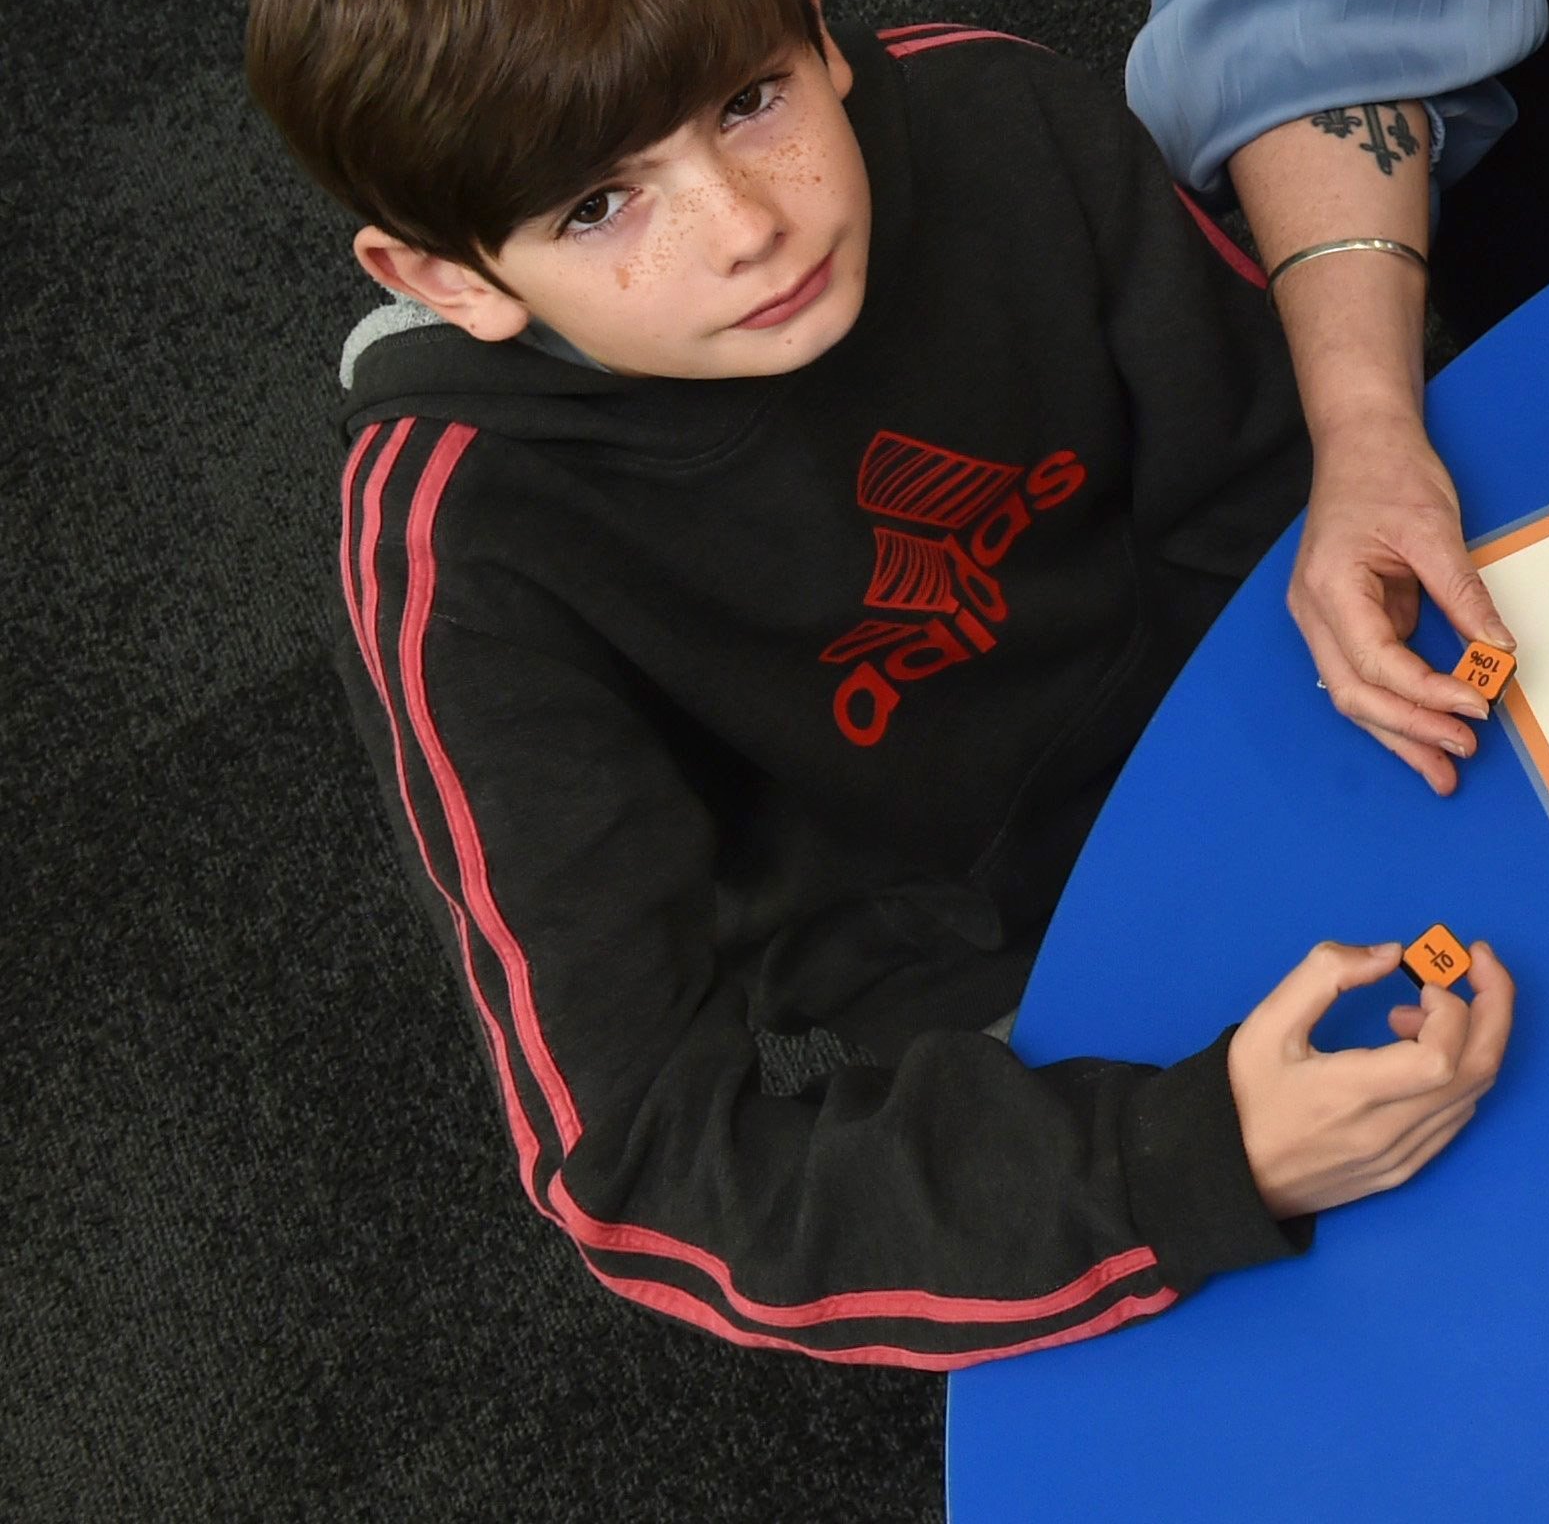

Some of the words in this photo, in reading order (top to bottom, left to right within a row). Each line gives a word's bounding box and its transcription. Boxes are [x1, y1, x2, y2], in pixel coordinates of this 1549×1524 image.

[833, 449, 1087, 747] adidas
[1470, 650, 1501, 673] 10%
[1467, 668, 1490, 687] 0.1
